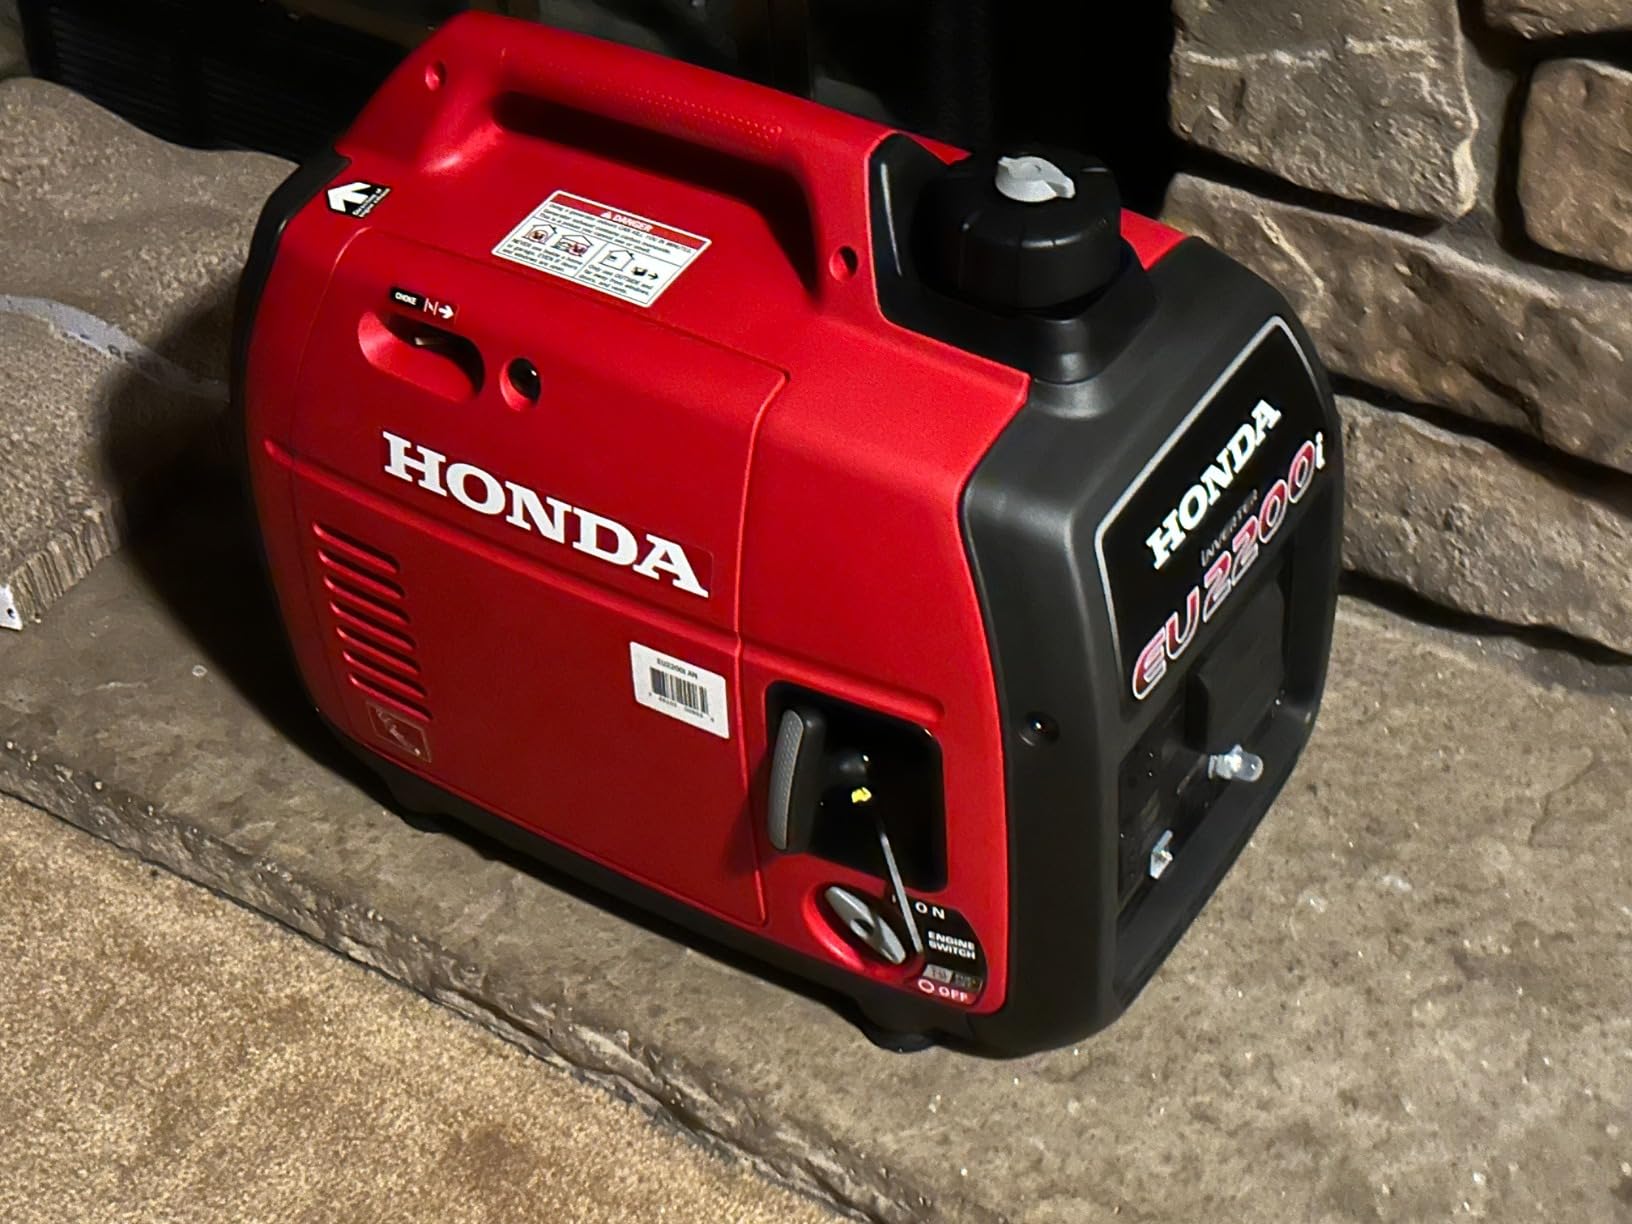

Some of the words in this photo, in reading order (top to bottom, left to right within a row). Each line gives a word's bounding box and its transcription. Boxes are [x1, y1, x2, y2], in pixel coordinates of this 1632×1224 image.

[611, 214, 654, 231] DANGER
[1145, 399, 1283, 570] HONDA
[383, 431, 708, 598] HONDA
[1132, 431, 1326, 700] EU2200i
[915, 900, 945, 920] ON
[927, 931, 976, 950] ENGINE
[928, 940, 976, 960] SWITCH
[938, 986, 968, 1002] OFF
